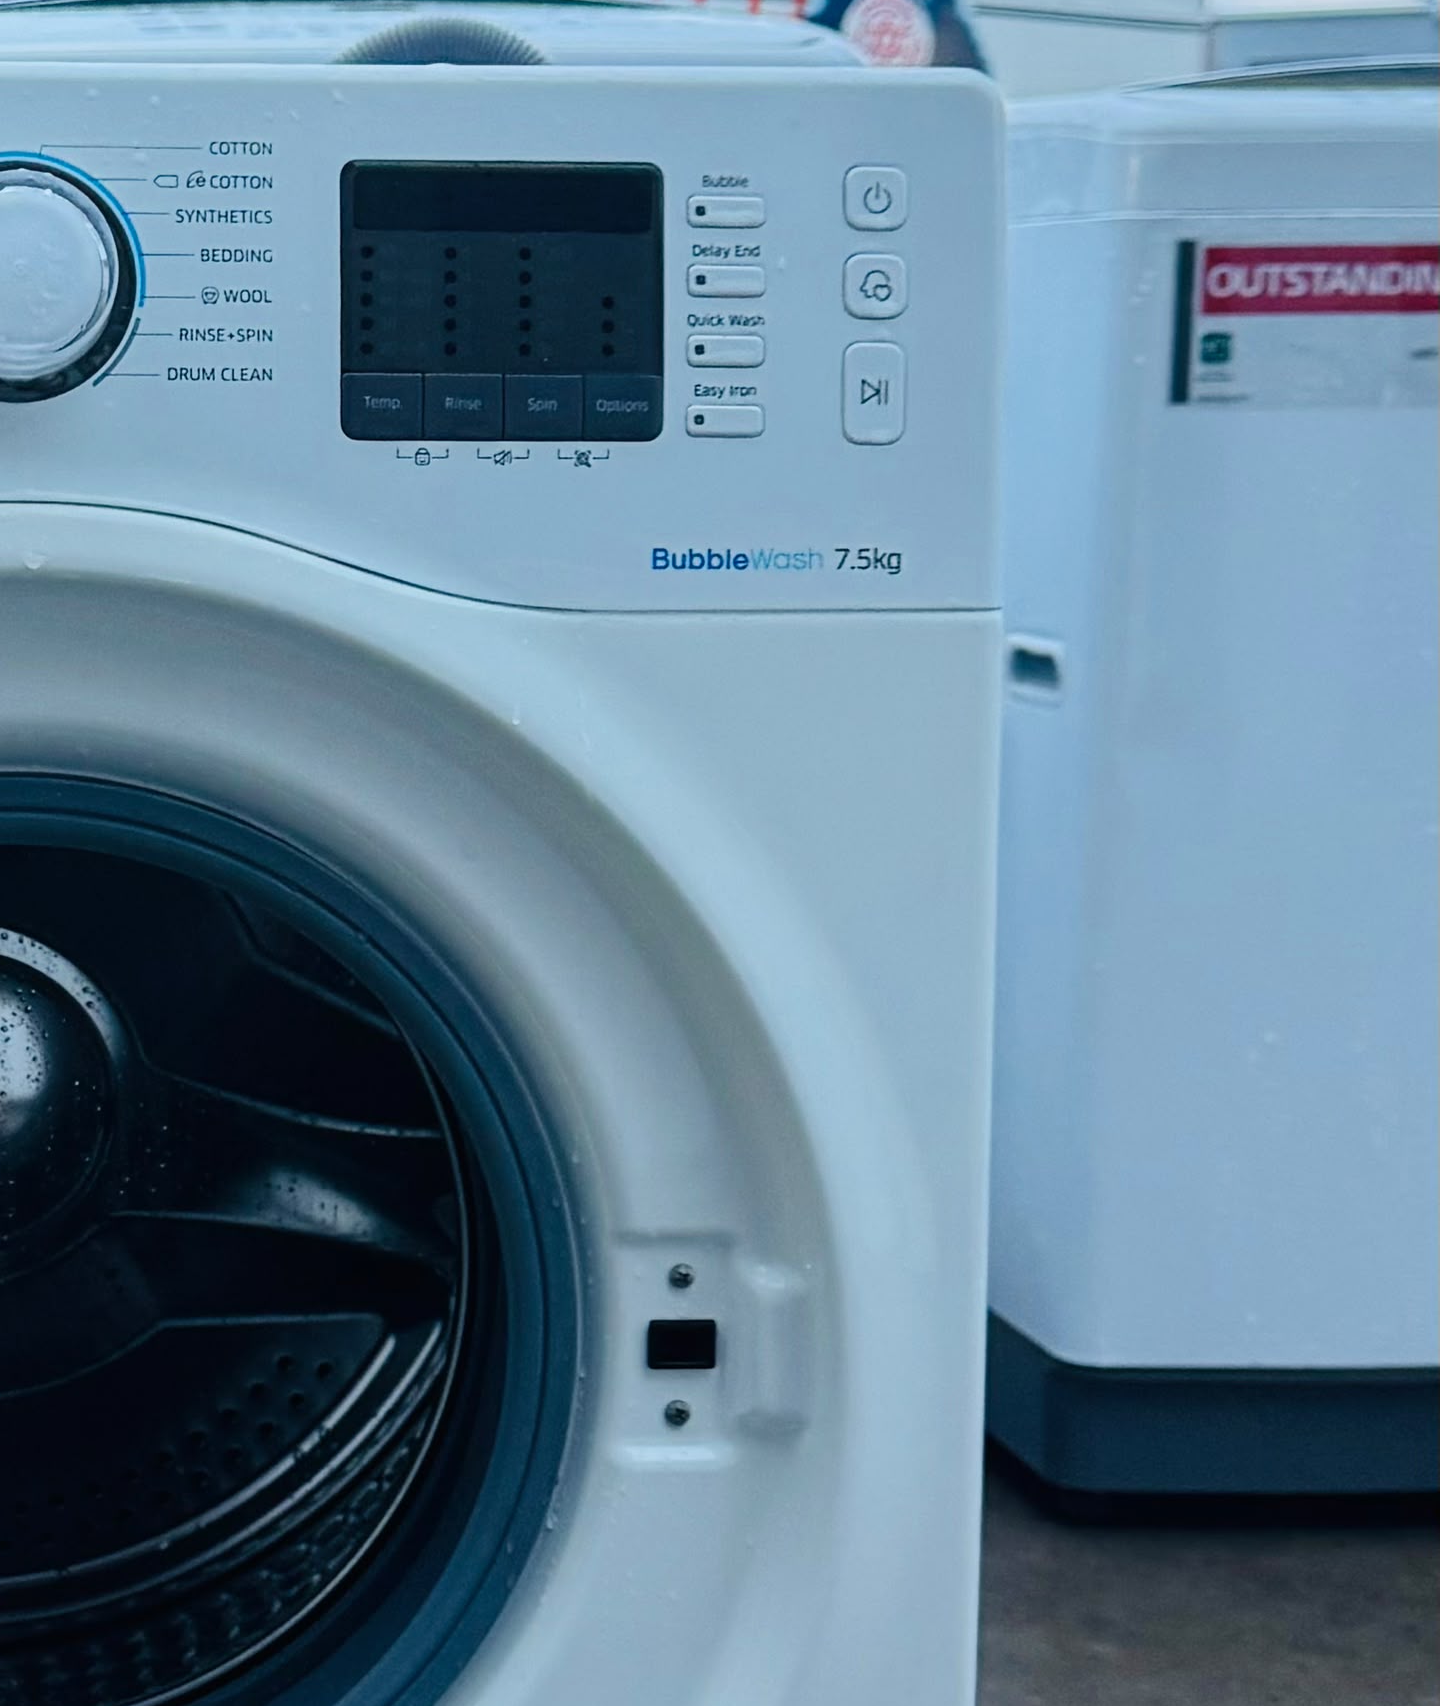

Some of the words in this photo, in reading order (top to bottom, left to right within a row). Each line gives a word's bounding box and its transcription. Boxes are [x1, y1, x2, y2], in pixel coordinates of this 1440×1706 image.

[209, 141, 272, 155] COTTON
[210, 175, 272, 189] COTTON
[176, 209, 273, 224] SYNTHETICS
[200, 249, 273, 263] BEDDING
[692, 244, 730, 259] Delay
[734, 244, 761, 257] End
[224, 289, 272, 303] WOOL
[687, 314, 724, 327] Quick
[728, 314, 765, 327] Wash
[179, 328, 273, 342] RINSE+SPIN
[168, 367, 216, 382] DRUM
[221, 368, 273, 382] CLEAN
[694, 383, 725, 399] Easy
[445, 397, 482, 410] Rinse
[527, 397, 558, 412] Spin
[596, 398, 649, 413] Options
[651, 548, 824, 570] BubbleWash
[834, 548, 902, 575] 7.5kg
